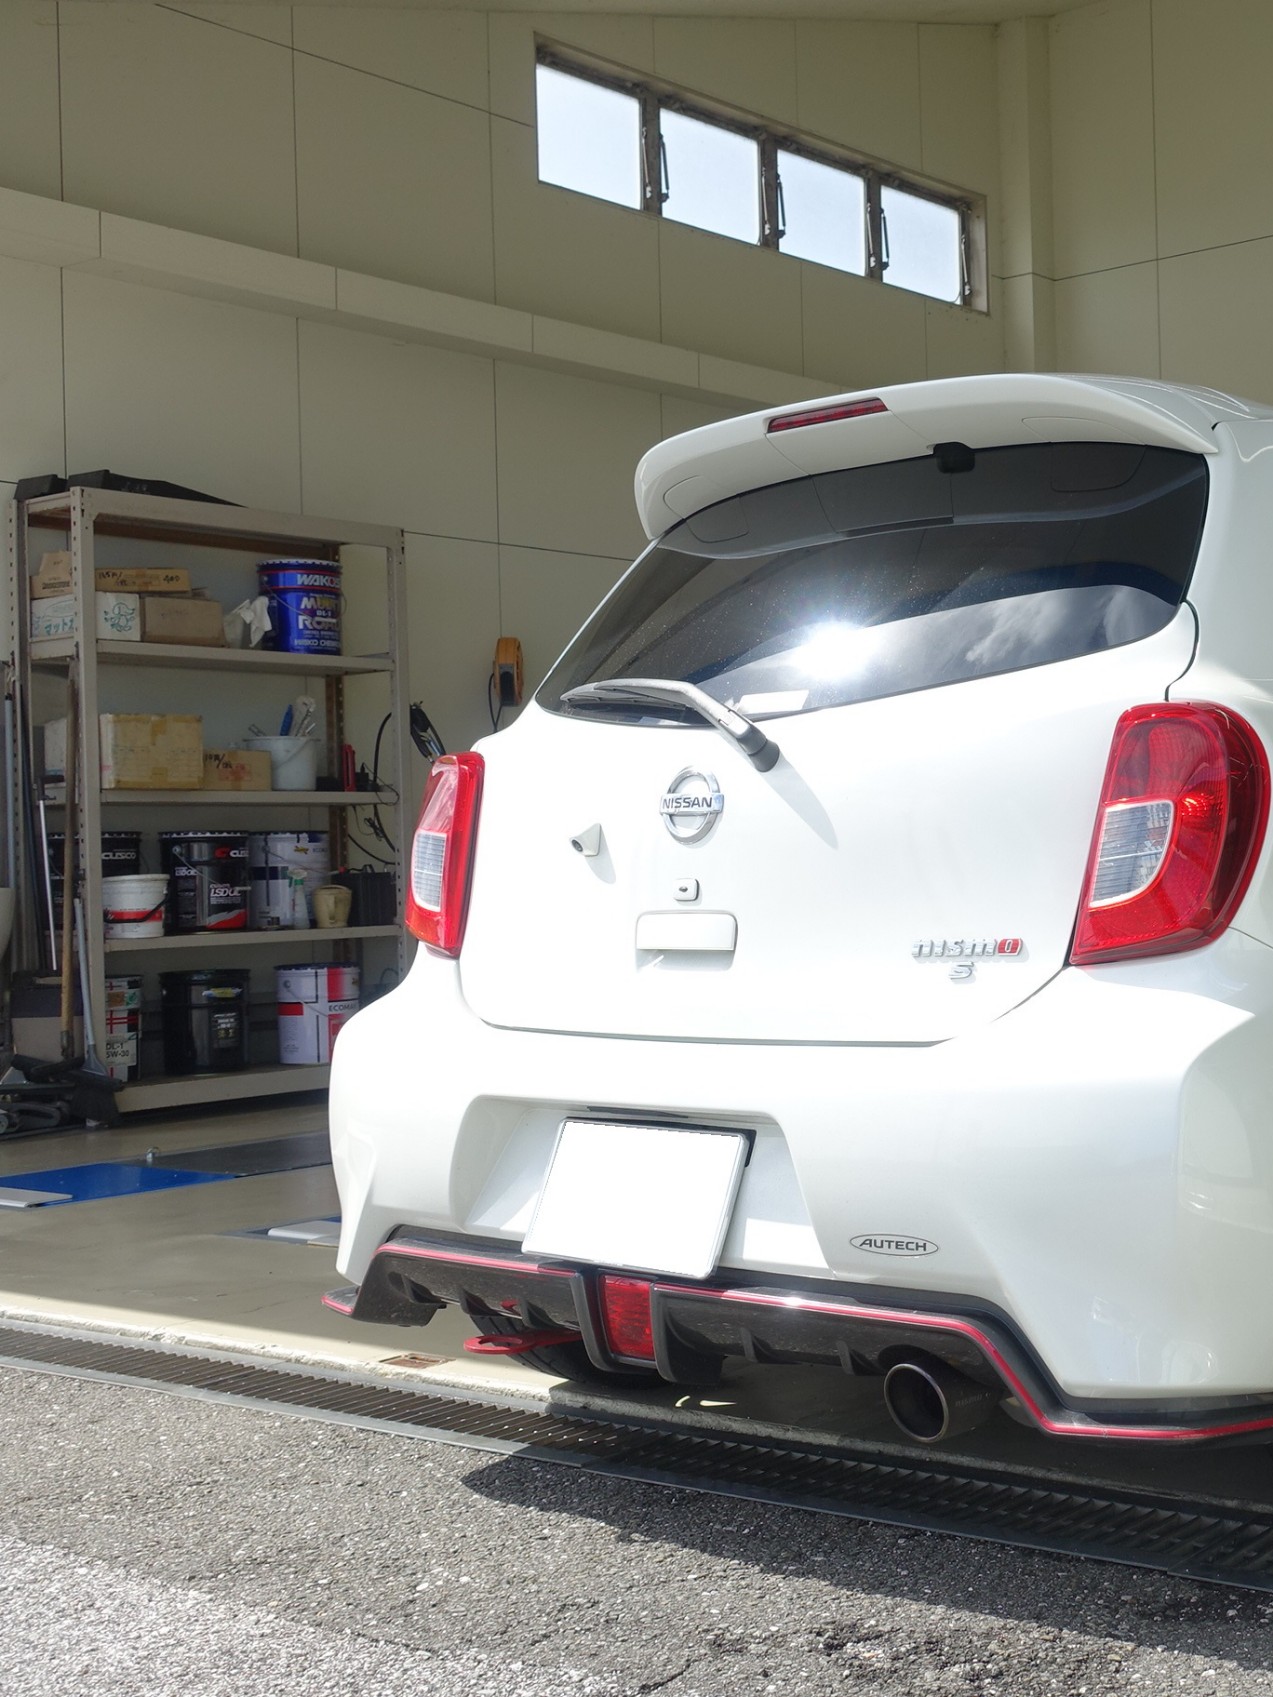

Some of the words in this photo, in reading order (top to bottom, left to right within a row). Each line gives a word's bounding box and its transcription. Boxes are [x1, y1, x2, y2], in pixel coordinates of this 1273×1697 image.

[662, 796, 713, 810] NISSAN
[948, 961, 975, 981] S
[859, 1238, 927, 1252] AUTECH
